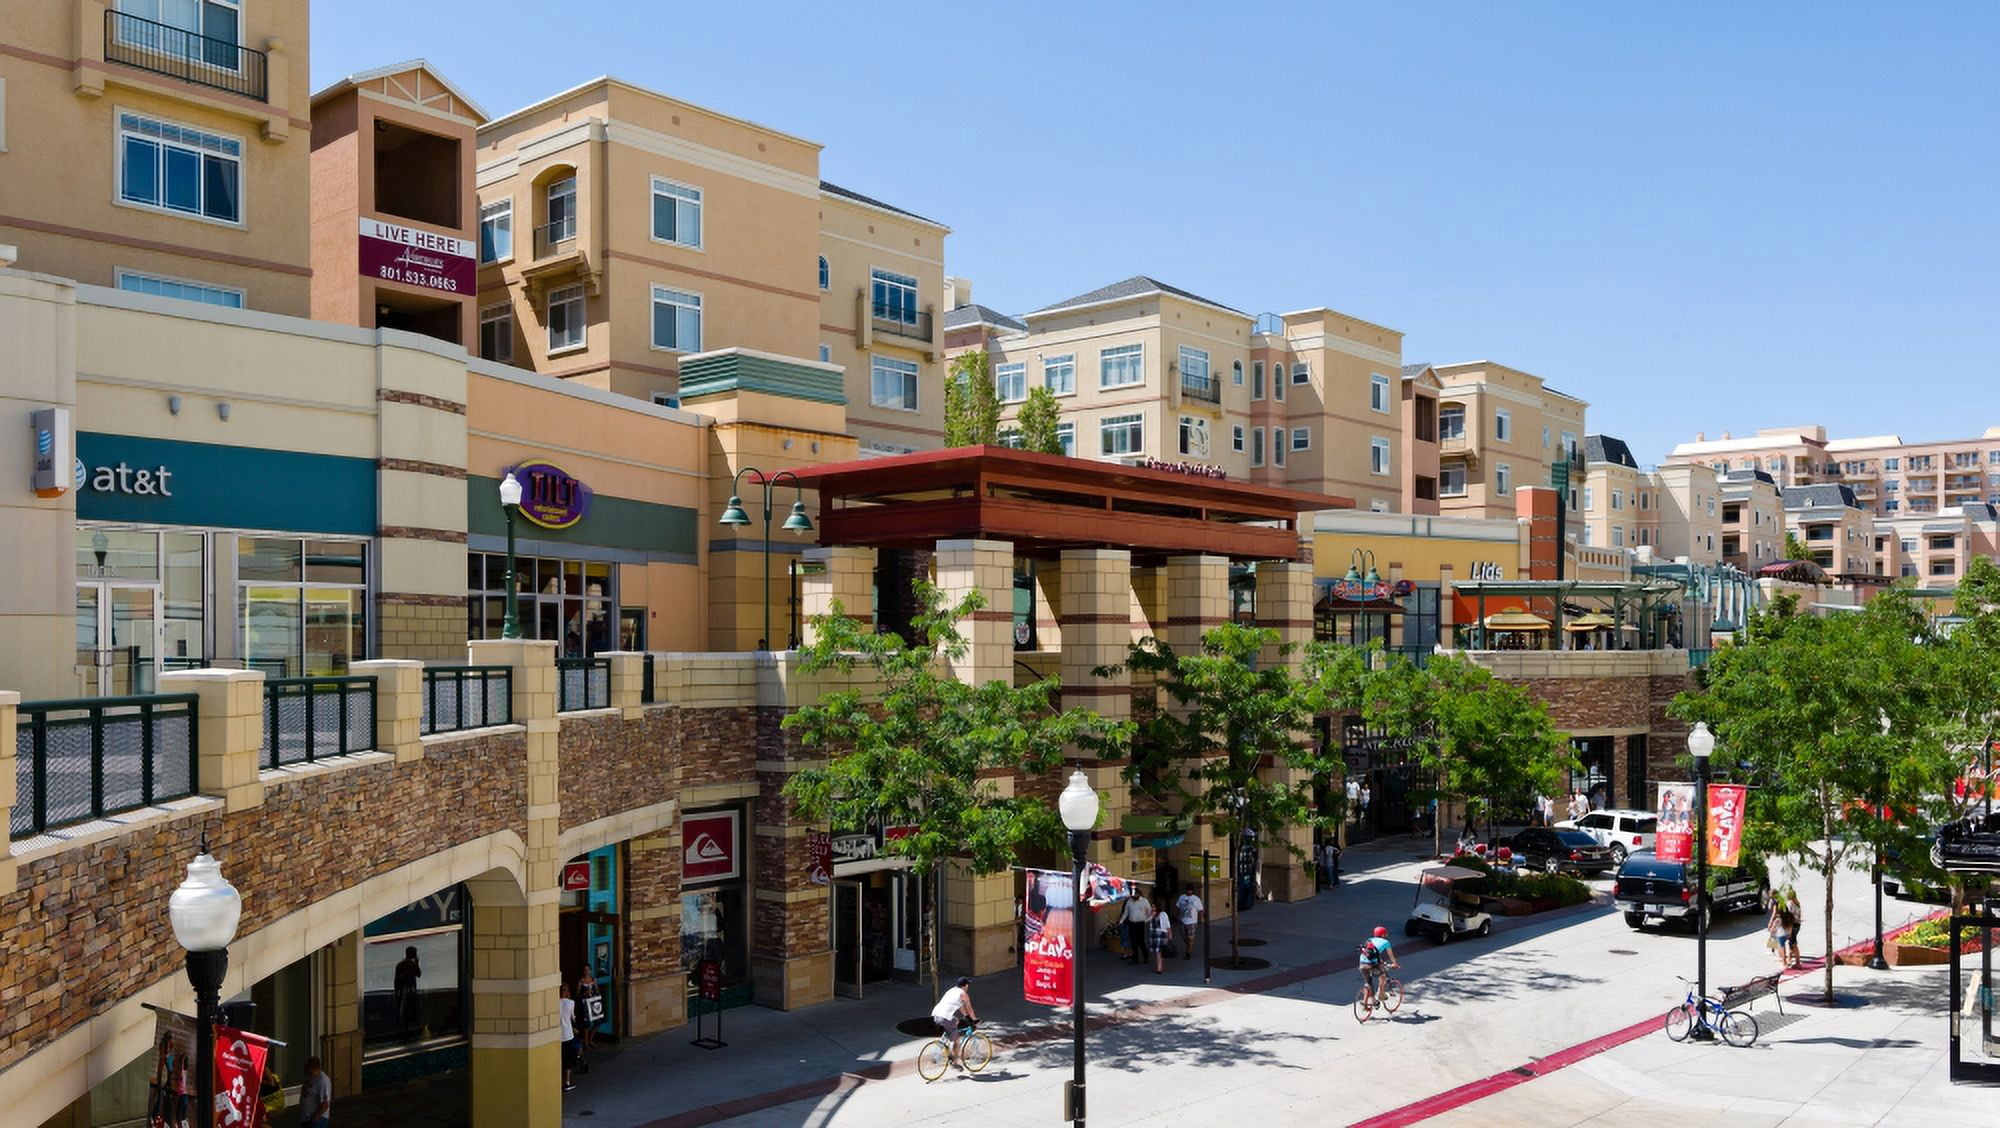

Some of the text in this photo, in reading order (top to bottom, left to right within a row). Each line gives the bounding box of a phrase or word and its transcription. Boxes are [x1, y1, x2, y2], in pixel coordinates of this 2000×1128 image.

[375, 223, 461, 255] LIVE HERE!
[92, 461, 173, 497] at&t
[530, 471, 577, 506] TILT
[1471, 560, 1504, 580] Lids
